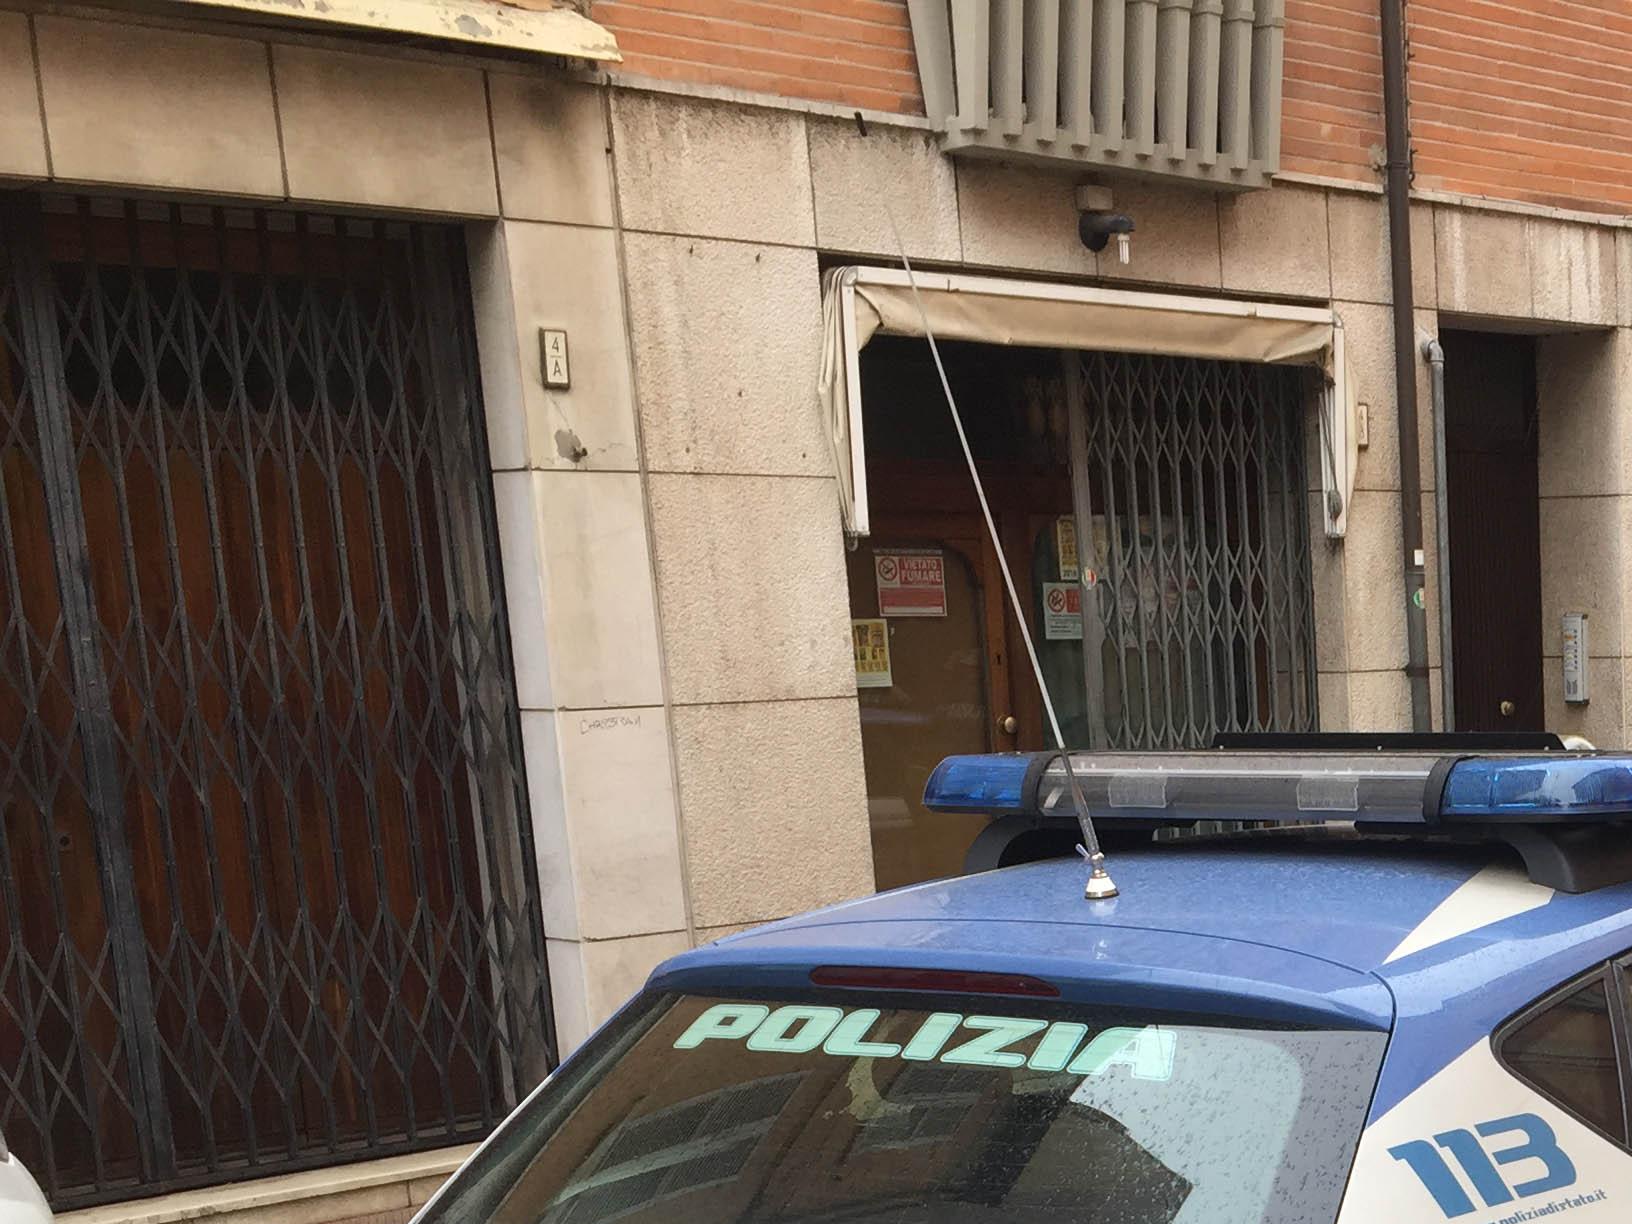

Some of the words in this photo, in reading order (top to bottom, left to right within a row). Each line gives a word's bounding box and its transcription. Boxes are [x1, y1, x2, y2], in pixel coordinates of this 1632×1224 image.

[551, 337, 560, 353] 4
[553, 359, 563, 376] A
[904, 559, 937, 570] VIETATO
[901, 570, 942, 582] FUMARE
[671, 1003, 1178, 1082] POLIZIA
[1386, 1112, 1578, 1220] 113
